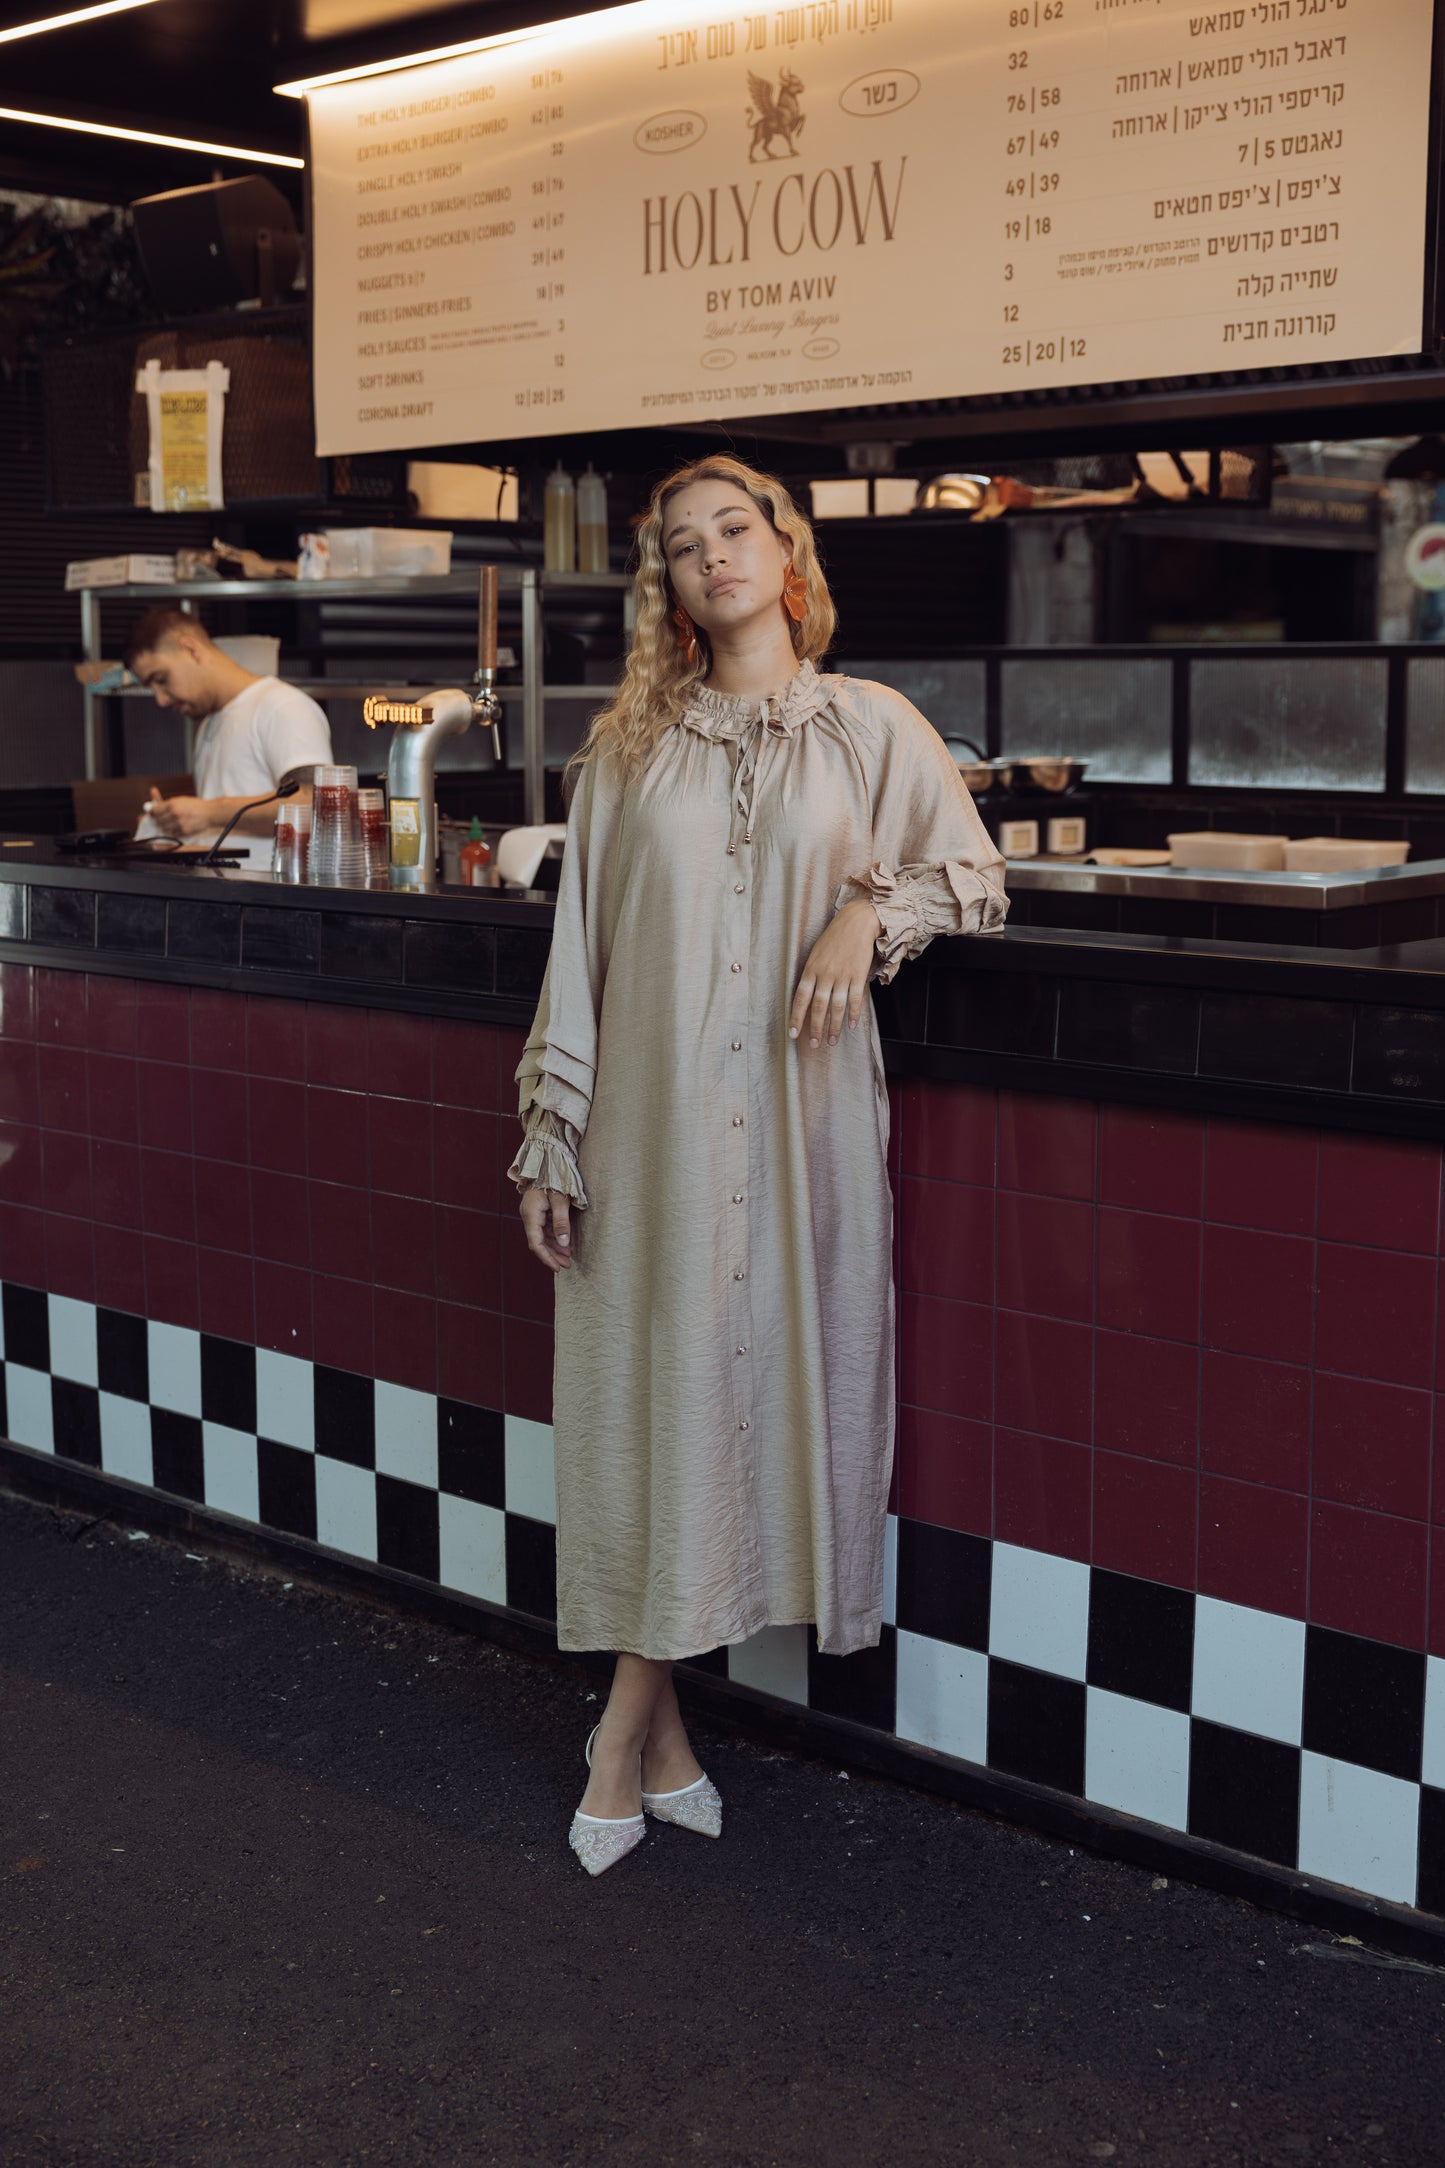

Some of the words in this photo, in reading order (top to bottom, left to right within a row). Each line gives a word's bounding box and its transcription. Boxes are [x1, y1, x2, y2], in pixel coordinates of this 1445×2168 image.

[1188, 8, 1246, 37] סמאש
[1250, 0, 1290, 24] הולי
[706, 22, 735, 61] טום
[744, 15, 768, 52] של
[656, 30, 699, 71] אביב
[1008, 50, 1029, 71] 32
[1248, 46, 1289, 70] הולי
[1293, 35, 1347, 63] דאבל
[1115, 67, 1172, 95] ארוחה
[1186, 54, 1244, 83] סמאש
[861, 81, 898, 107] כשר
[1232, 95, 1273, 118] הולי
[1277, 82, 1345, 111] קריספי
[358, 112, 377, 129] THE
[380, 107, 407, 123] HOLY
[1111, 111, 1168, 139] ארוחה
[644, 121, 694, 144] KOSHER
[1280, 128, 1343, 157] נאגטס
[357, 142, 390, 162] EXTRA
[392, 136, 419, 155] HOLY
[358, 174, 395, 194] SINGLE
[397, 169, 425, 187] HOLY
[358, 208, 399, 228] DOUBLE
[401, 202, 428, 221] HOLY
[641, 180, 761, 276] HOLY
[771, 155, 908, 256] COW
[1153, 192, 1213, 220] חטאים
[396, 238, 424, 255] HOLY
[425, 228, 471, 250] CHICKEN
[1206, 230, 1275, 258] קדושים
[1279, 220, 1339, 248] רטבים
[1003, 263, 1015, 282] 3
[1279, 266, 1338, 292] שתייה
[705, 288, 732, 314] BY
[737, 282, 782, 309] TOM
[788, 275, 838, 303] AVIV
[1236, 273, 1275, 299] קלה
[358, 307, 388, 324] FRIES
[441, 297, 472, 314] FRIES
[1003, 303, 1020, 324] 12
[1222, 320, 1269, 345] חבית
[1272, 313, 1337, 338] קורונה
[358, 342, 385, 357] HOLY
[387, 336, 427, 353] SAUCES
[358, 374, 384, 390] SOFT
[386, 370, 425, 387] DRINKS
[861, 373, 876, 388] על
[358, 406, 400, 423] CORONA
[402, 401, 435, 418] DRAFT
[363, 694, 424, 730] Corona
